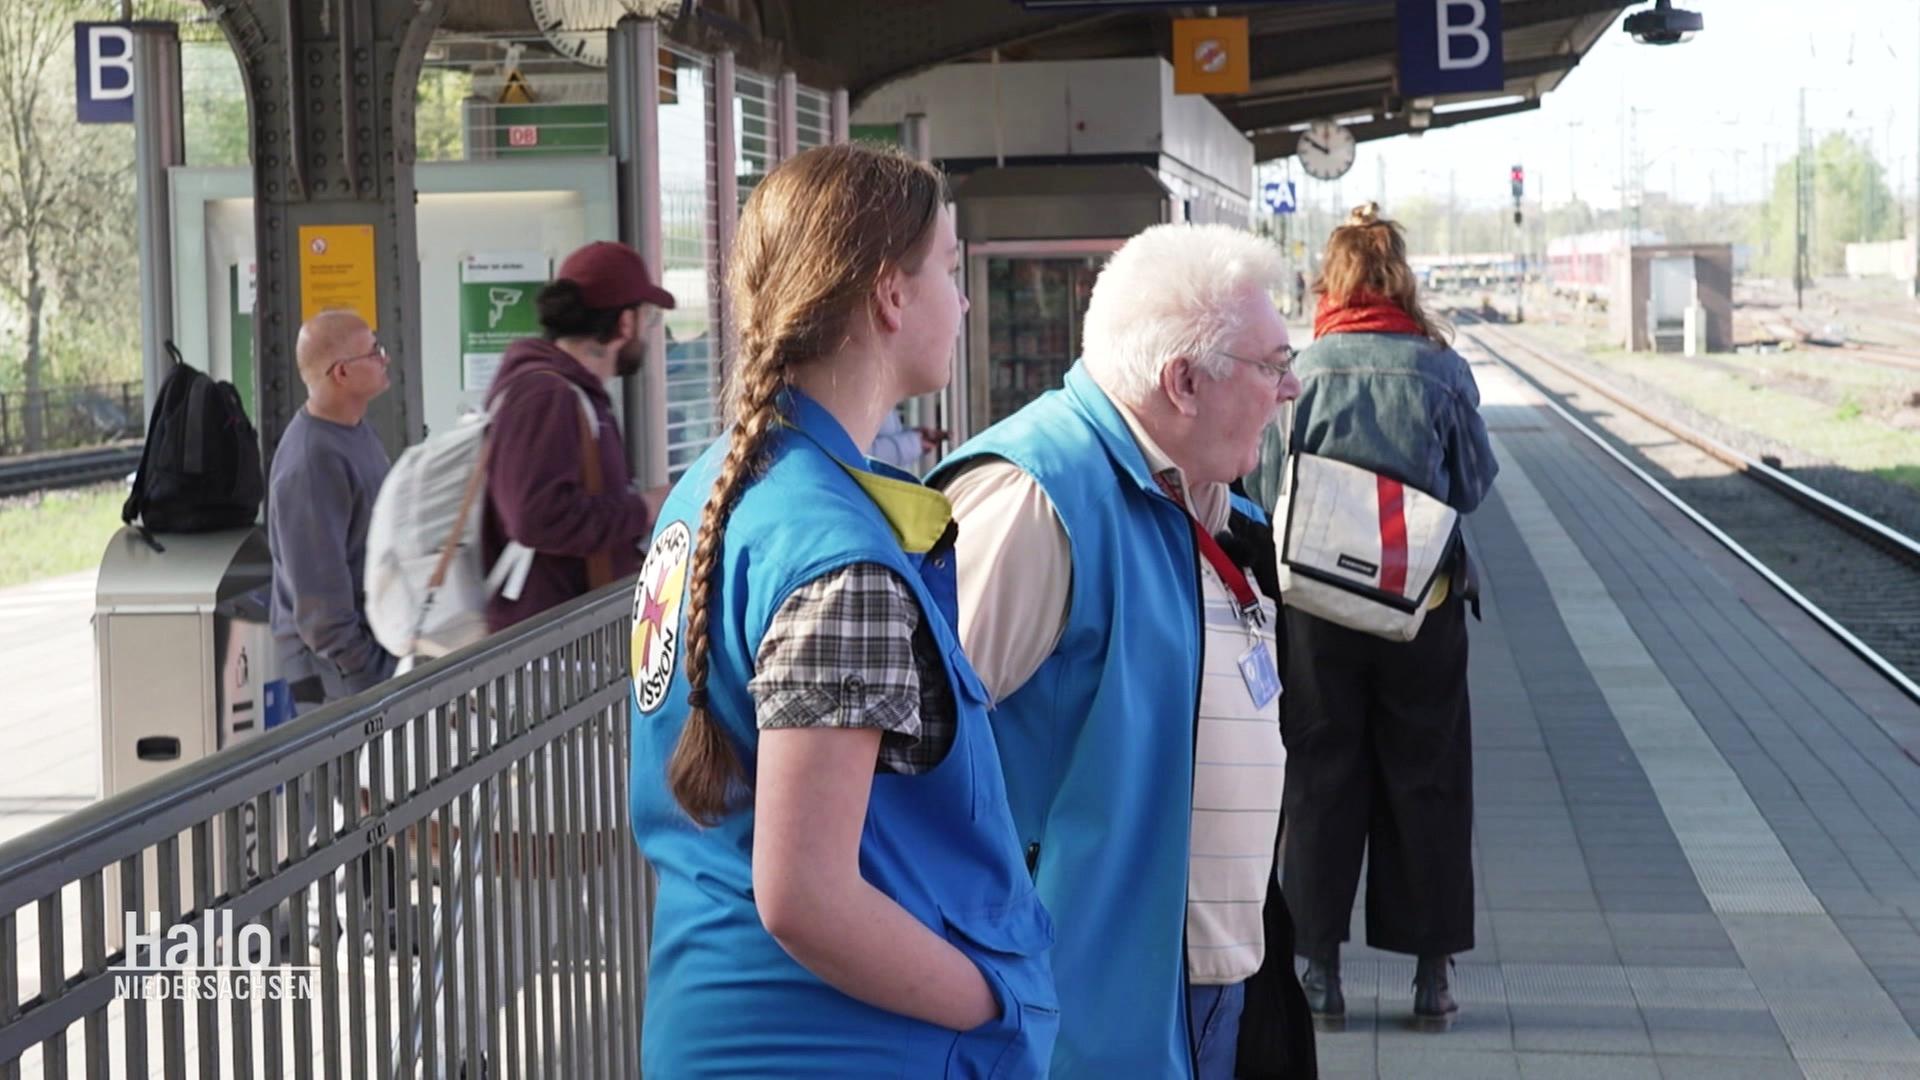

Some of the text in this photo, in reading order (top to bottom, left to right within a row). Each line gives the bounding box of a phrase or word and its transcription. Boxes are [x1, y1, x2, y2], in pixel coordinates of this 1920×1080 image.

[88, 27, 134, 100] B
[1436, 0, 1489, 70] B
[511, 127, 537, 146] DB
